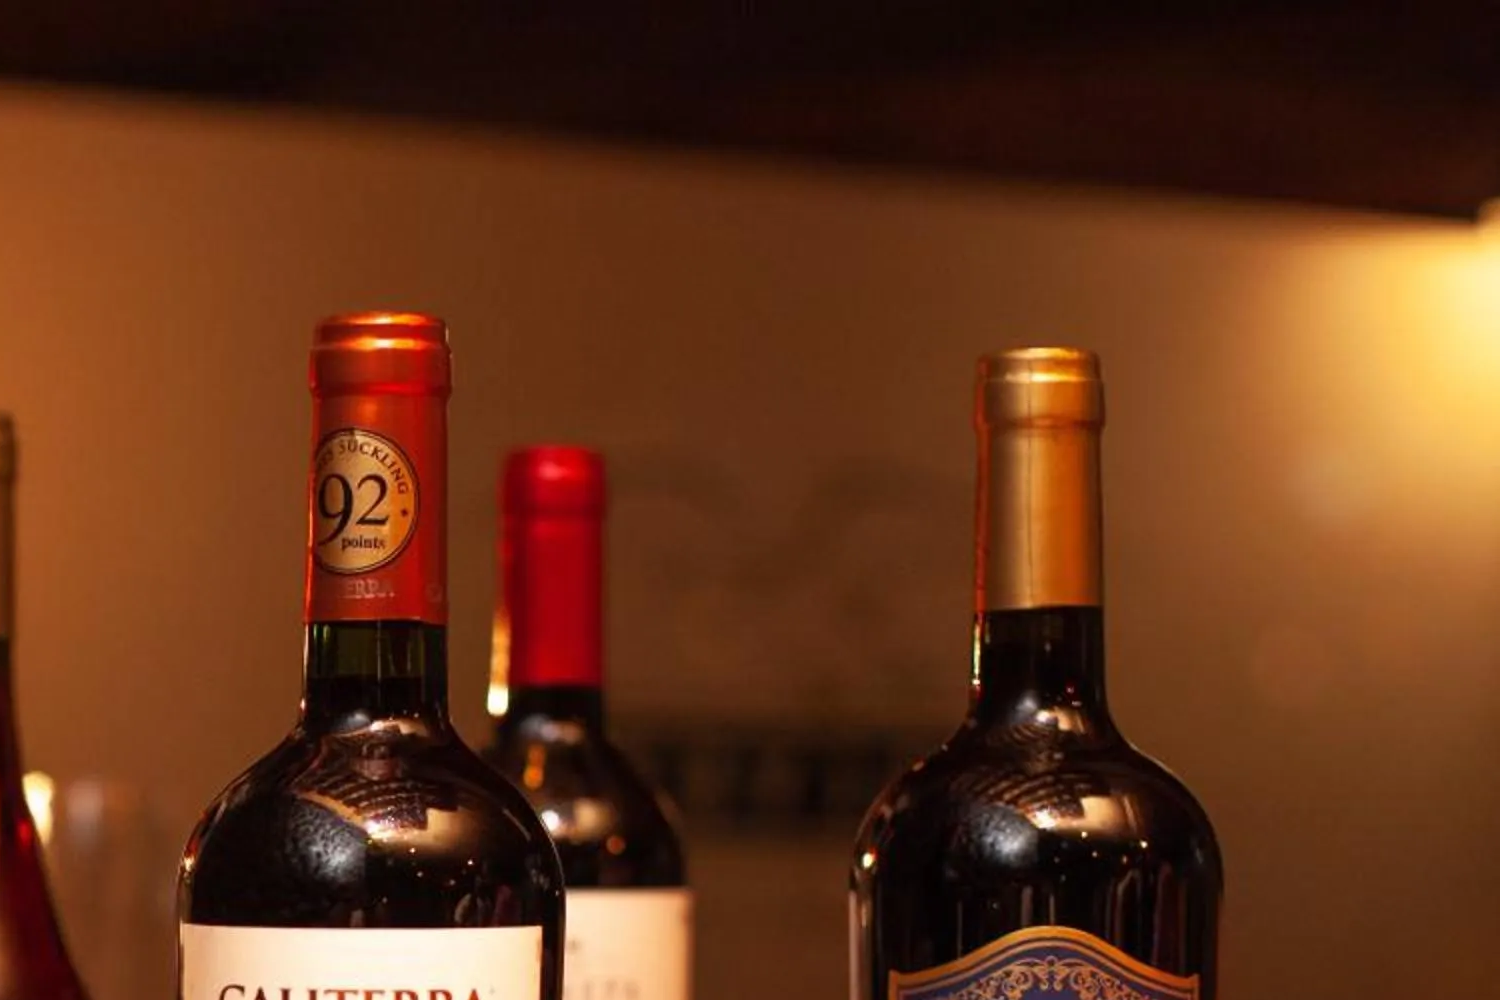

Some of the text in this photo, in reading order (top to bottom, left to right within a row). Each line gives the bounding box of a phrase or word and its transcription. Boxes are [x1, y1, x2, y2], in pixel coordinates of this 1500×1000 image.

[339, 438, 410, 495] SUCKLING
[318, 473, 390, 546] 92
[341, 534, 386, 551] points
